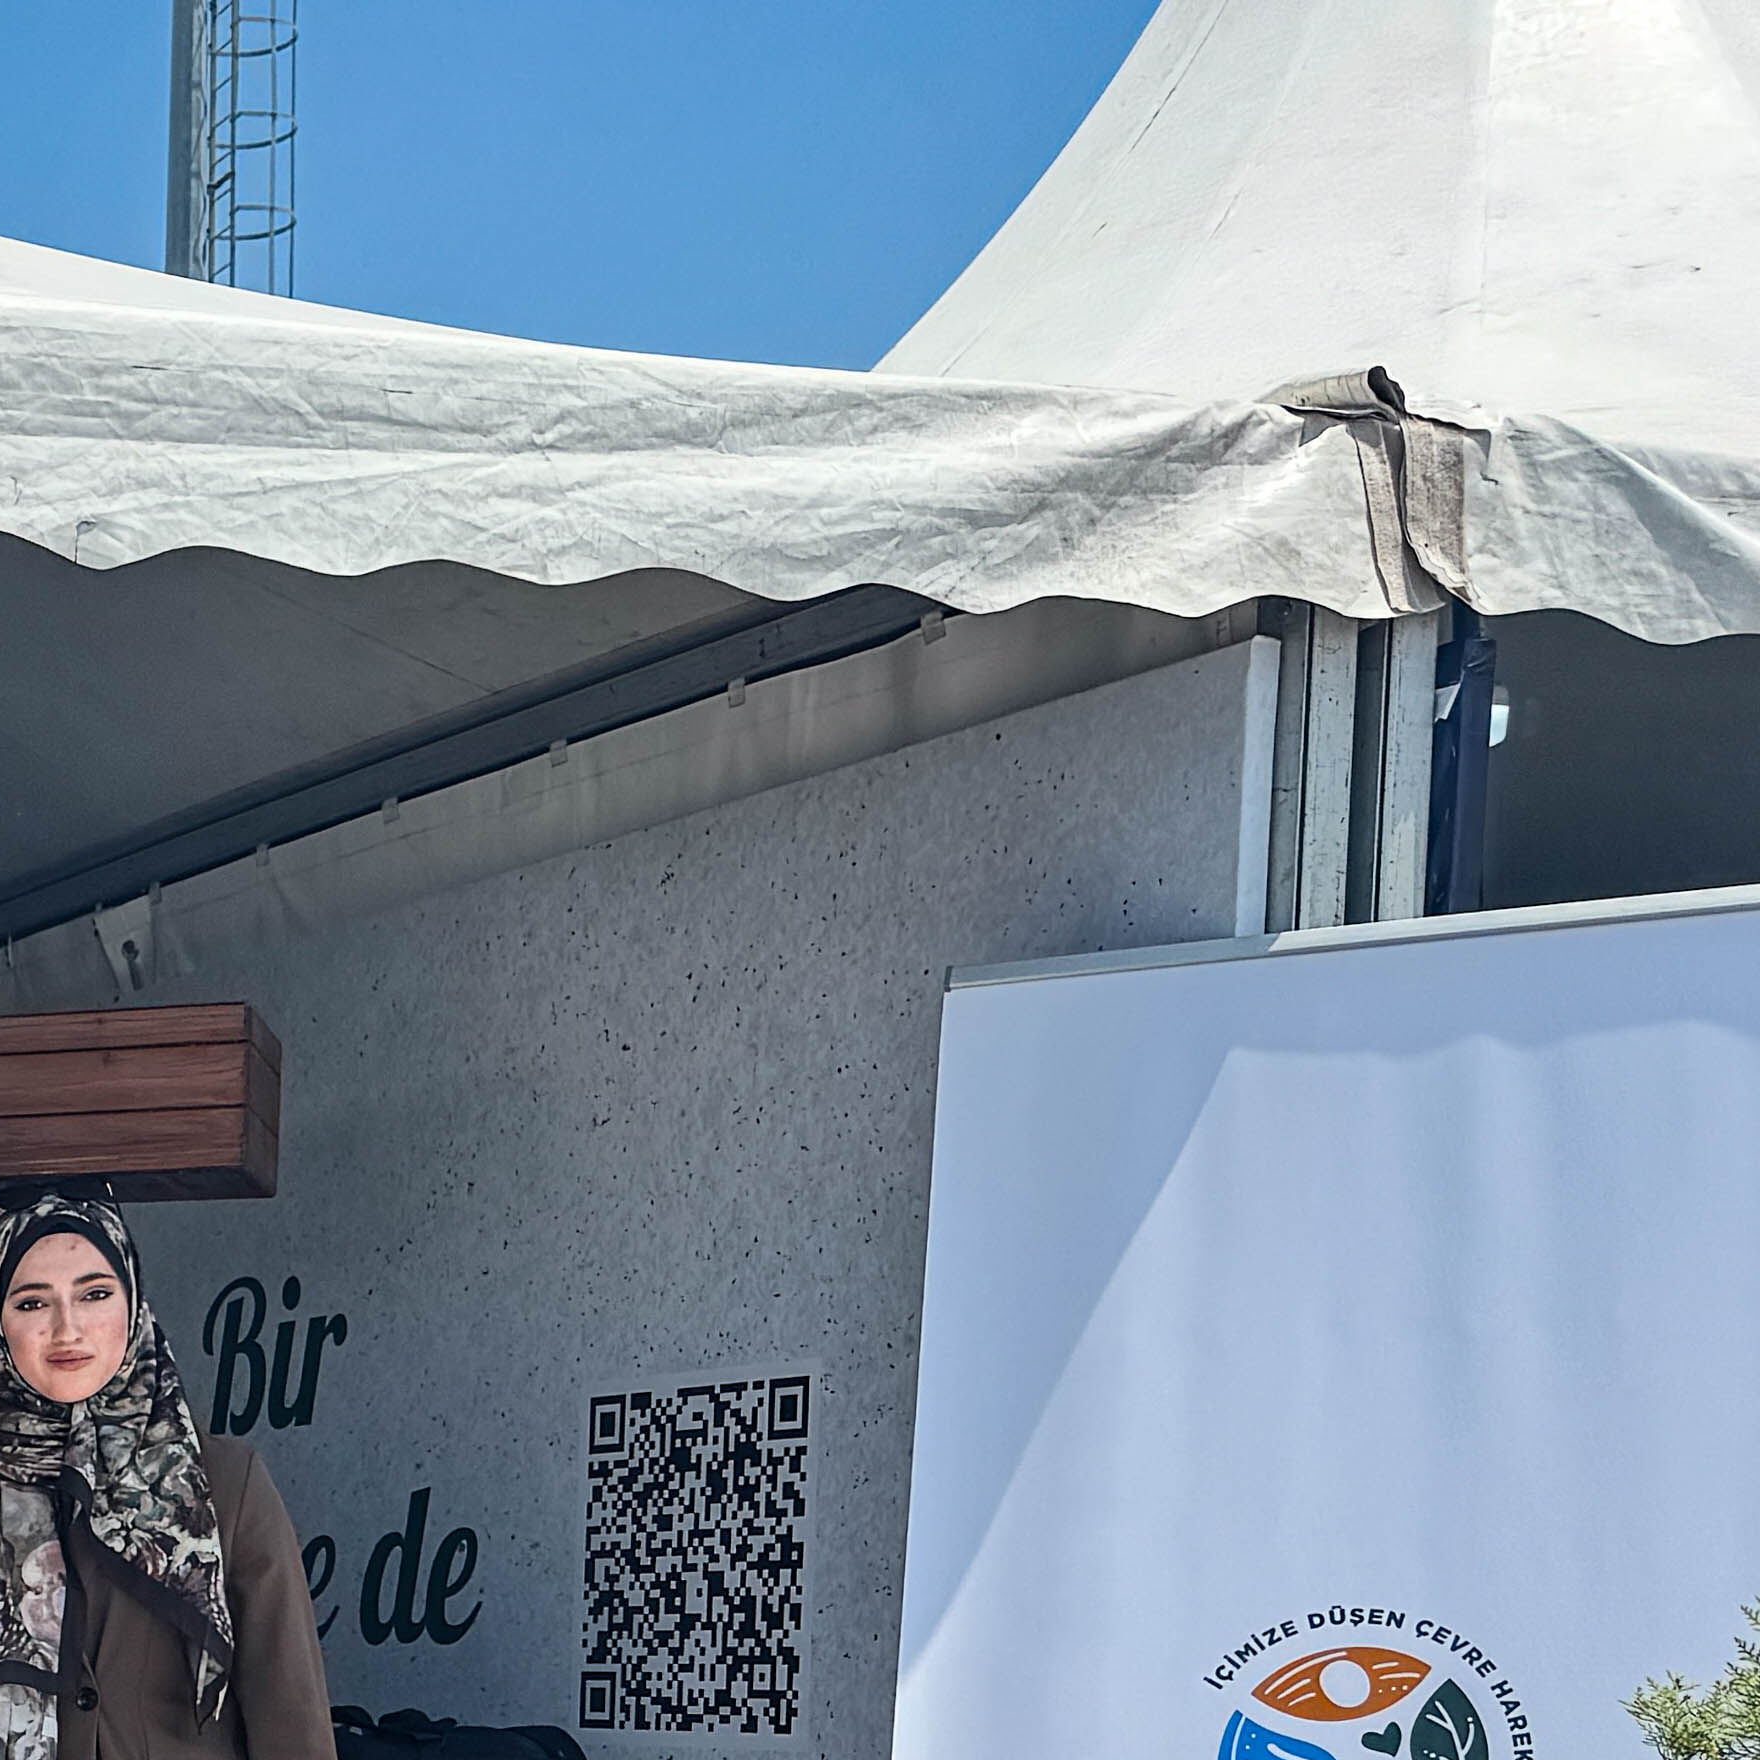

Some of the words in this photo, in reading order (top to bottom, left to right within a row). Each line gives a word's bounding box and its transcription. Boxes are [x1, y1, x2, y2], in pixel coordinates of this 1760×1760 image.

[202, 1275, 348, 1437] Bir
[359, 1486, 483, 1646] de
[1203, 1619, 1299, 1690] İÇİMİZE
[1307, 1605, 1406, 1629] DÜŞEN
[1415, 1619, 1498, 1678] ÇEVRE
